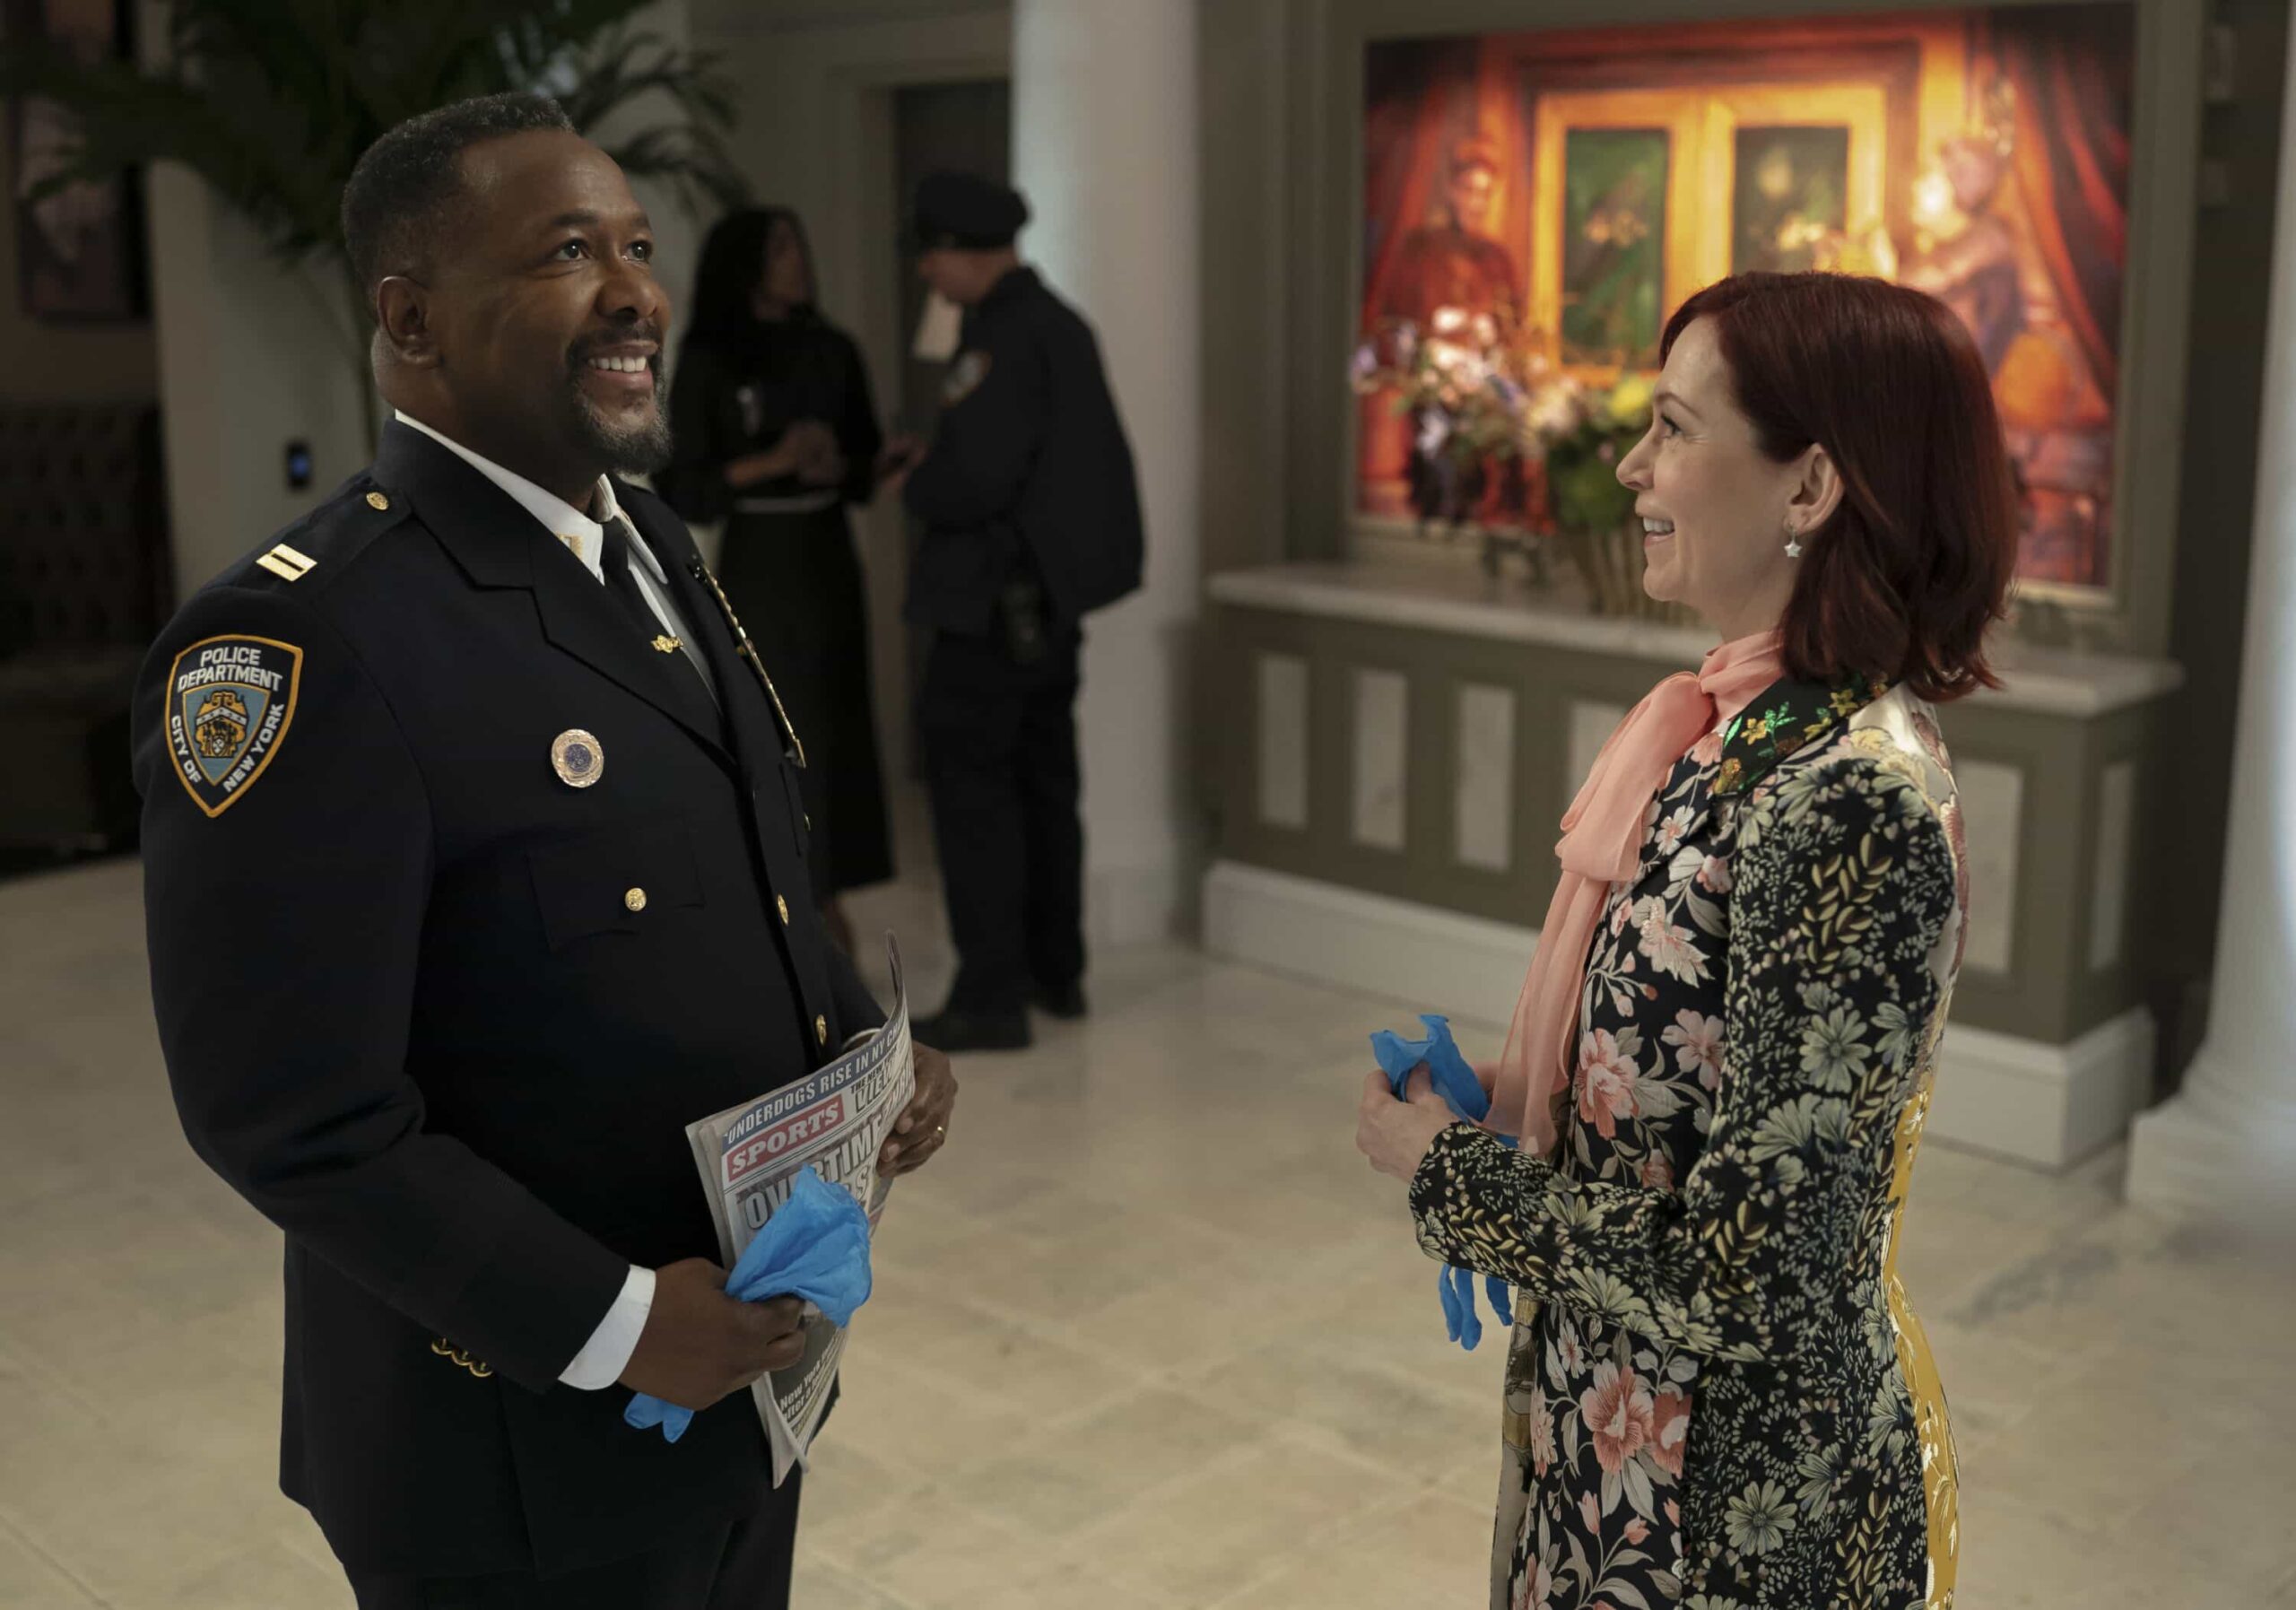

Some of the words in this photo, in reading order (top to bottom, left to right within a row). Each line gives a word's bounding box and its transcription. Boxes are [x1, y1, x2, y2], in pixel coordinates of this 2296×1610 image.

[178, 664, 283, 692] DEPARTMENT
[200, 646, 261, 667] POLICE
[171, 715, 189, 756] CITY
[183, 760, 202, 784] OF
[222, 754, 256, 793] NEW
[250, 703, 285, 754] YORK
[728, 1082, 816, 1144] UNDERDOGS
[820, 1062, 852, 1093] RISE
[856, 1051, 869, 1074] IN
[731, 1102, 839, 1175] SPORTS
[780, 1383, 803, 1412] New
